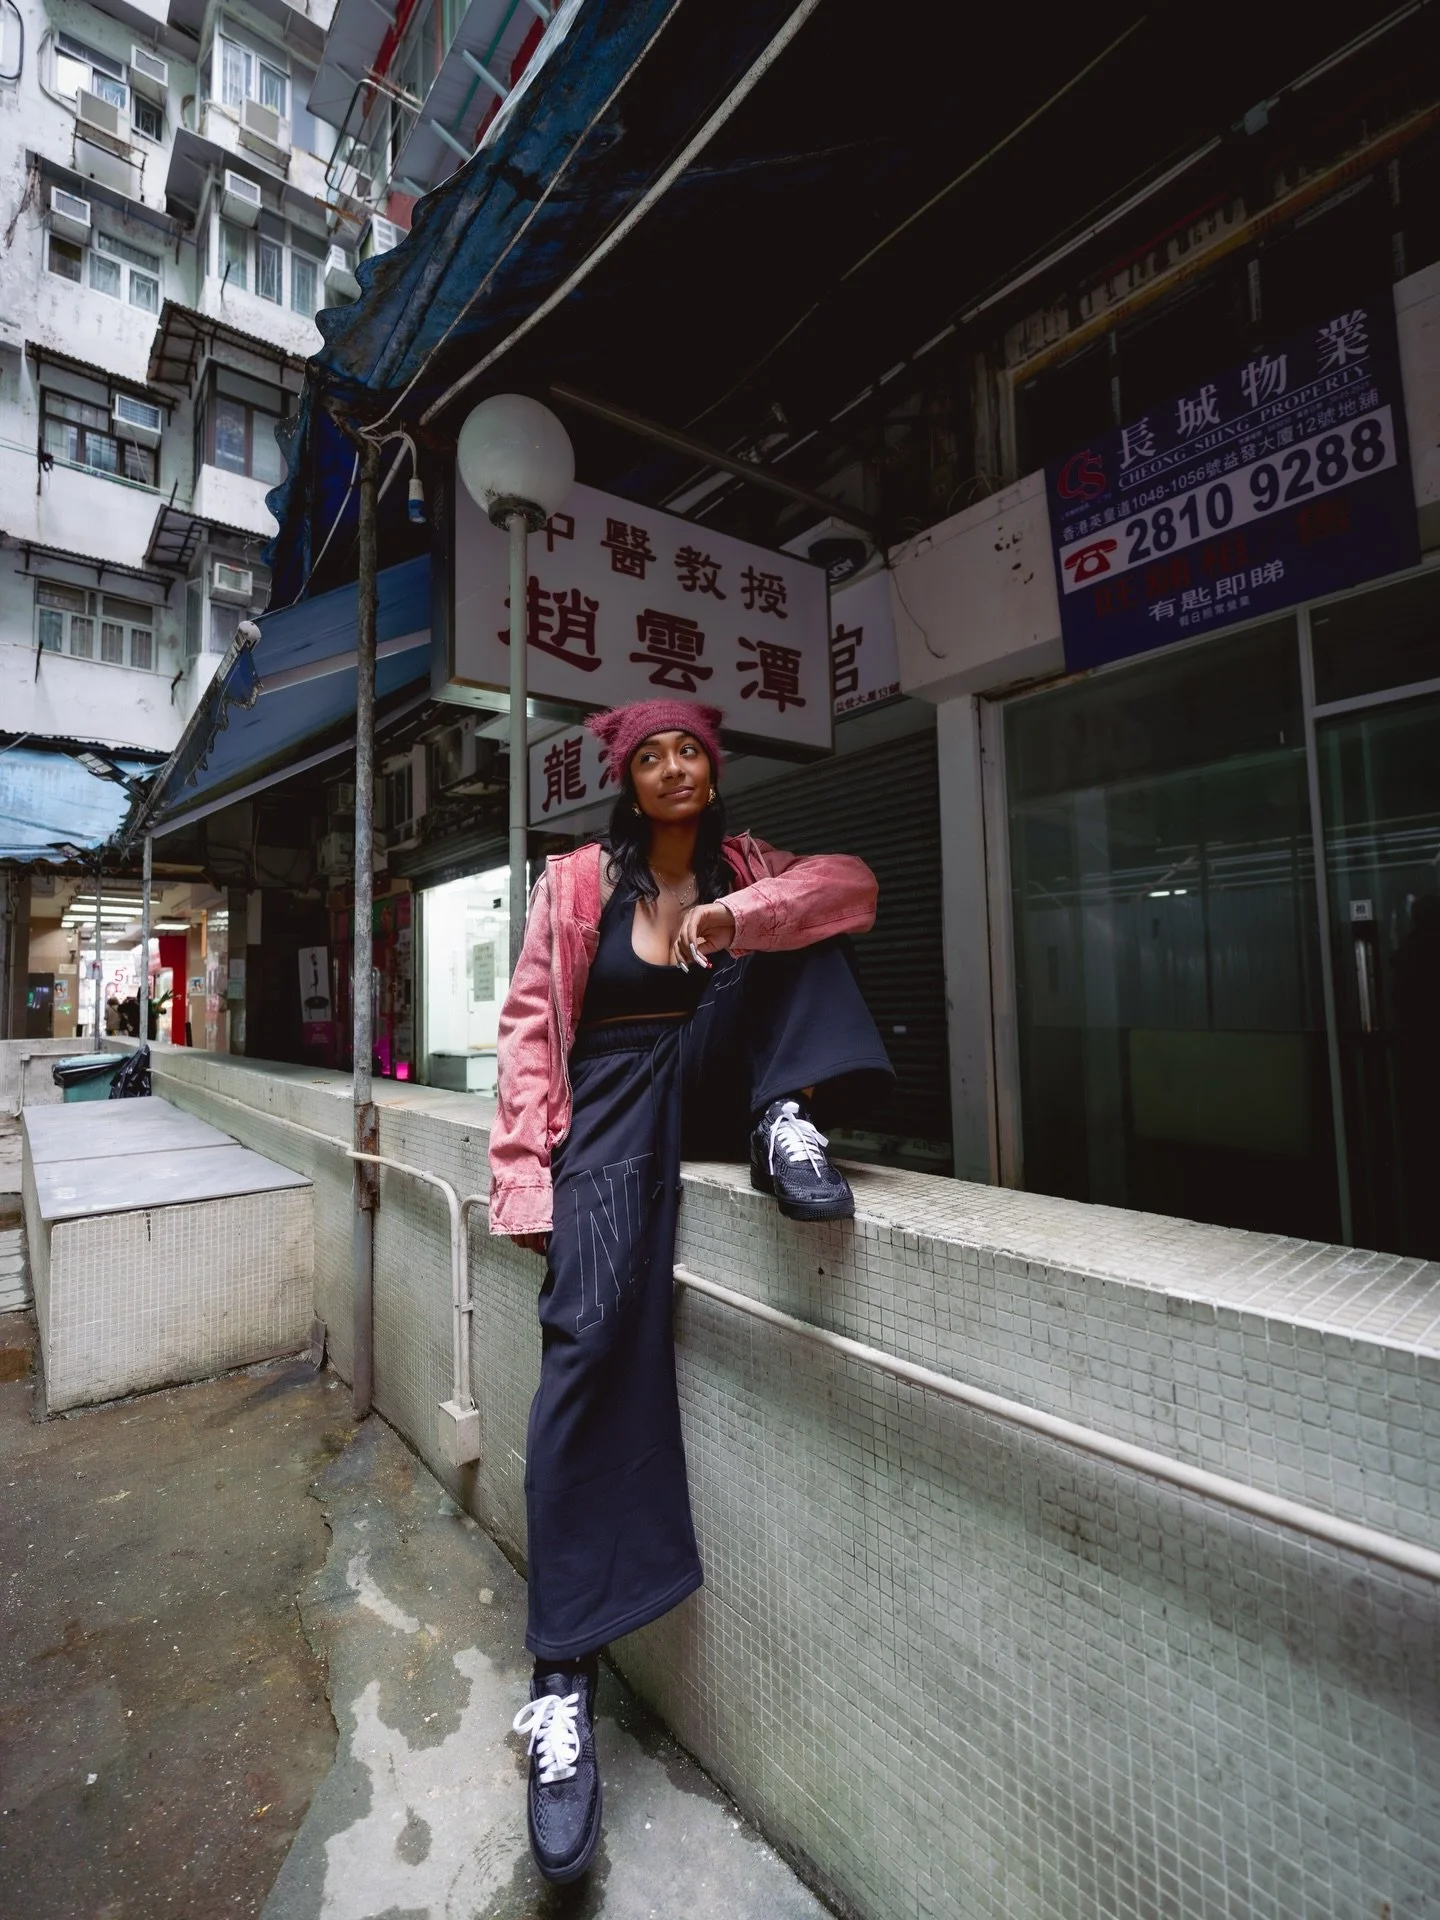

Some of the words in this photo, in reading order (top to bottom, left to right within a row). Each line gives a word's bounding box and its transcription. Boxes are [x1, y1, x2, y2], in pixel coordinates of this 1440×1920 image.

[1116, 309, 1369, 470] 長城物業
[1118, 448, 1187, 489] CHEONG
[1194, 418, 1250, 453] SHING
[1260, 363, 1366, 422] PROPERTY
[1125, 482, 1234, 565] 2810
[1249, 418, 1387, 511] 9288
[497, 575, 807, 713] 趙雲潭
[1148, 558, 1286, 623] 有匙即睇
